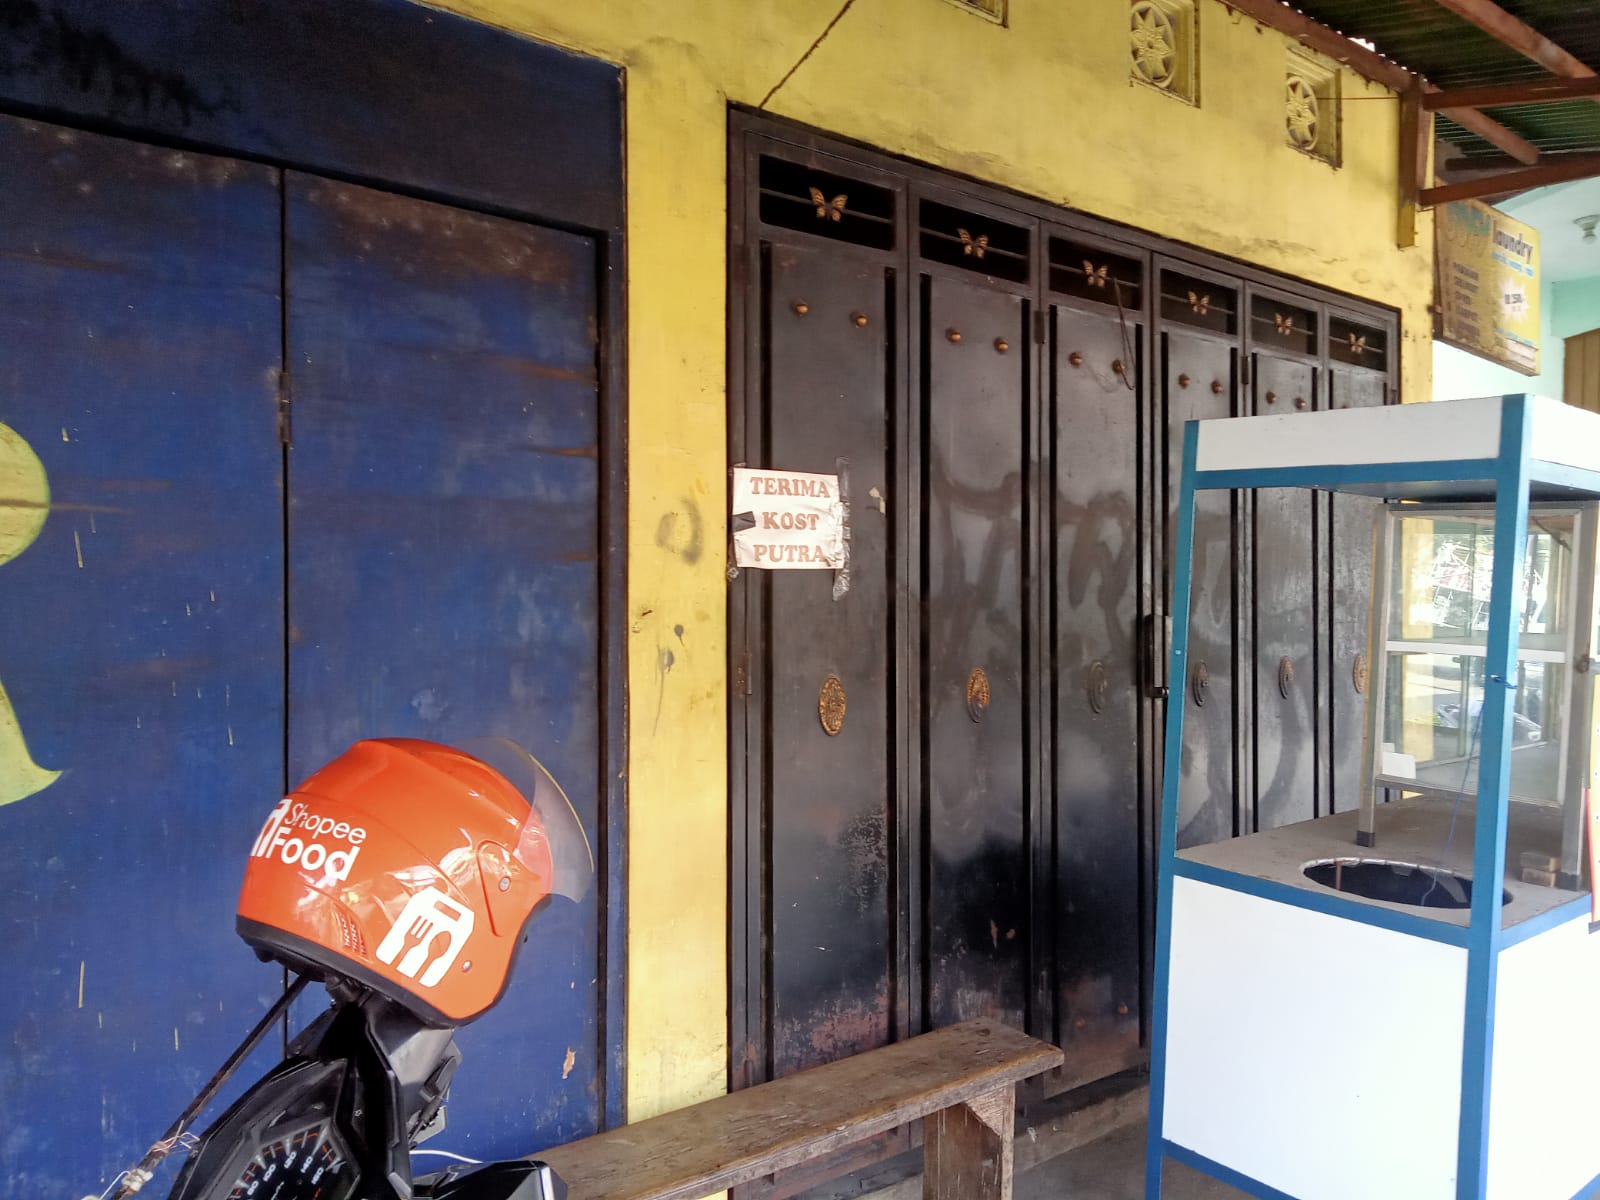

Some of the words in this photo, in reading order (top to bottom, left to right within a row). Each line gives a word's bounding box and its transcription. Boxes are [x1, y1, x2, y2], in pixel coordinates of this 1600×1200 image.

[750, 477, 831, 498] TERIMA
[762, 512, 820, 531] KOST
[753, 544, 827, 563] PUTRA
[284, 803, 367, 844] Shopee
[265, 826, 361, 881] Food
[263, 1164, 276, 1181] 100
[301, 1156, 313, 1173] 140
